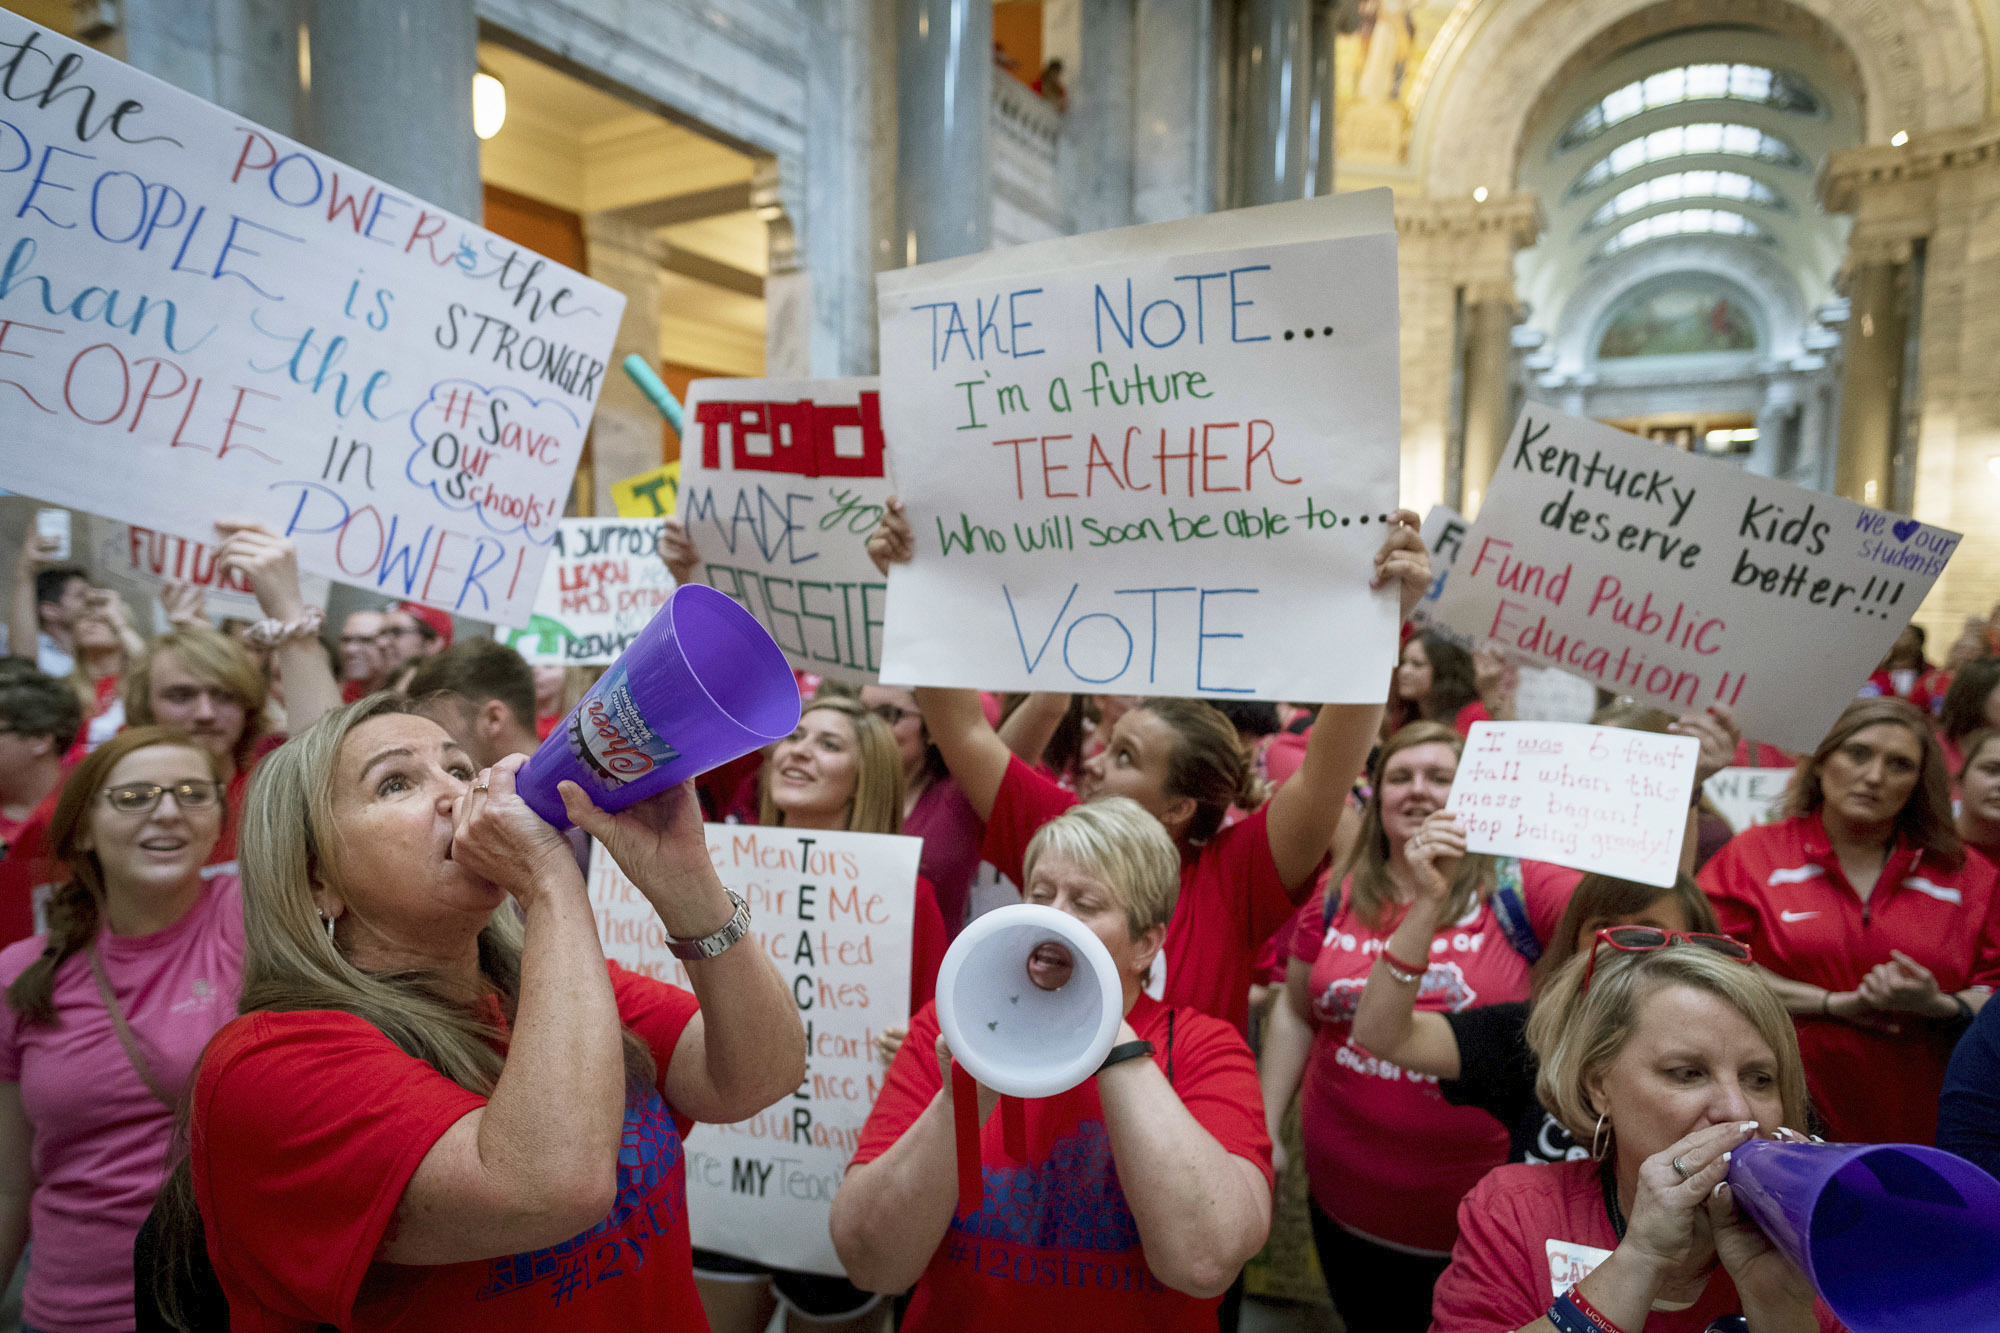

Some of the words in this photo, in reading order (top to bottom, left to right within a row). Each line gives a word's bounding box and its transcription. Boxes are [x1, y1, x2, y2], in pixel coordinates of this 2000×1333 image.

[0, 31, 184, 149] the
[231, 126, 456, 266] POWER
[461, 239, 603, 324] the
[343, 268, 395, 331] is
[435, 302, 605, 402] STRONGER
[911, 288, 1046, 371] TAKE
[1095, 265, 1334, 354] NOTE...
[249, 306, 411, 422] the
[955, 370, 1030, 431] I'm
[1048, 377, 1072, 413] a
[1082, 361, 1215, 407] future
[321, 424, 375, 491] in
[432, 433, 500, 478] Our
[993, 419, 1303, 500] TEACHER
[1513, 417, 1696, 528] Kentucky
[1739, 496, 1831, 556] Kids
[446, 470, 556, 529] Schools!
[685, 484, 819, 563] MADE
[819, 487, 886, 541] yo
[936, 512, 1007, 557] Who
[1014, 515, 1074, 552] will
[1168, 507, 1219, 543] be
[1224, 506, 1290, 540] able
[1856, 509, 1887, 537] We
[1914, 530, 1958, 557] our
[268, 480, 526, 613] POWER!
[1470, 536, 1573, 606] Fund
[1540, 489, 1702, 570] deserve
[1731, 548, 1905, 620] better!!!
[1003, 582, 1260, 693] VOTE
[612, 690, 645, 747] Megaphone
[1477, 731, 1505, 753] I
[1516, 736, 1563, 755] was
[1458, 792, 1522, 810] mess
[1468, 761, 1521, 782] tall
[1538, 763, 1612, 794] when
[1625, 773, 1680, 802] this
[1515, 814, 1578, 854] being
[829, 886, 890, 925] Me
[731, 1157, 774, 1198] MY
[771, 1157, 841, 1201] Teac
